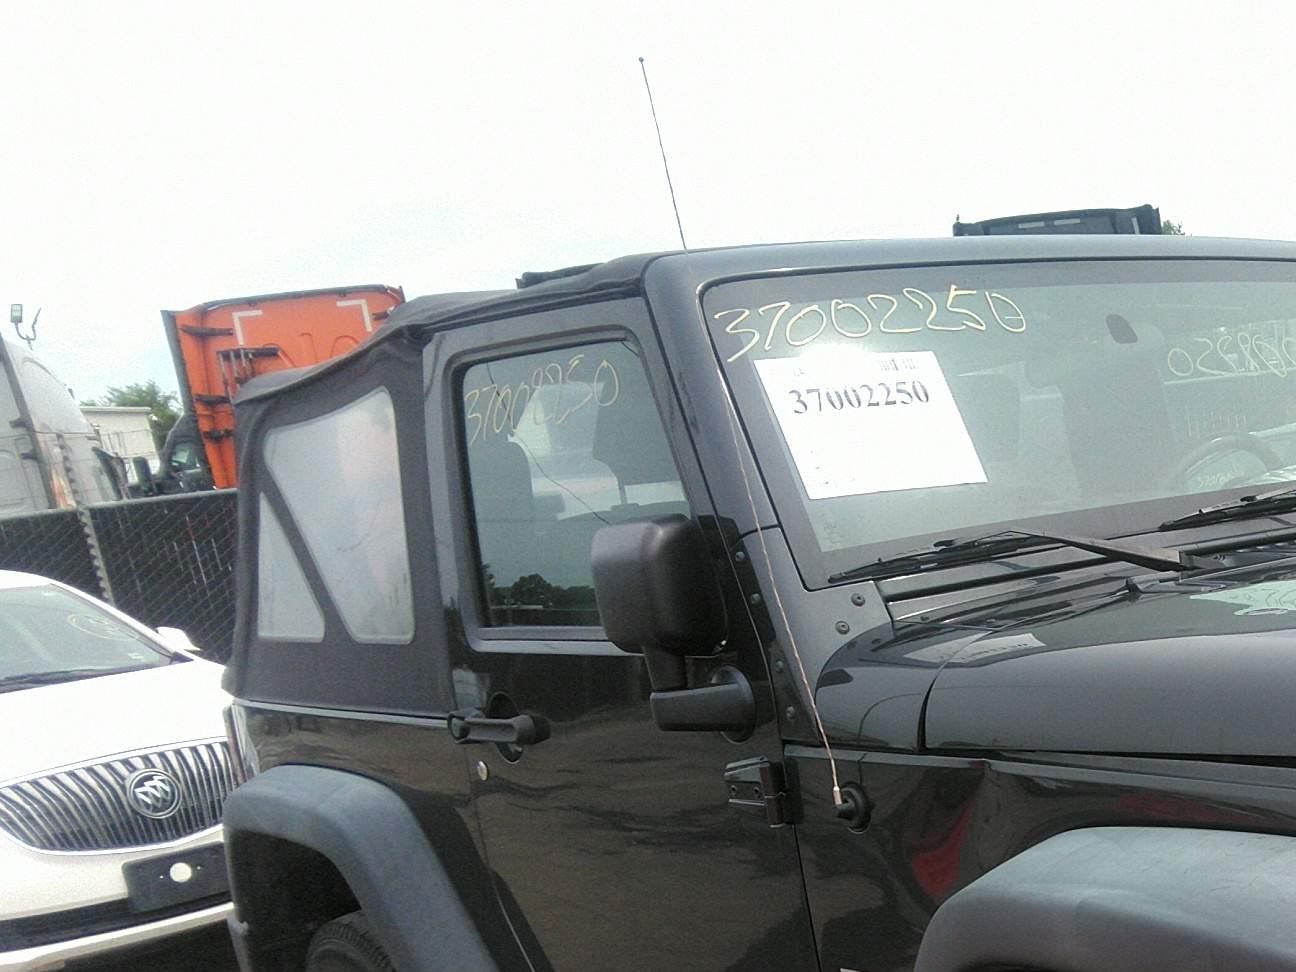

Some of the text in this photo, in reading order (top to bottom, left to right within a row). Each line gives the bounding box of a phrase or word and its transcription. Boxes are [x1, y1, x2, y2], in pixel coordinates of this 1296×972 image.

[714, 284, 1026, 362] 37002250
[463, 354, 619, 446] 37002250
[788, 379, 930, 415] 37002250
